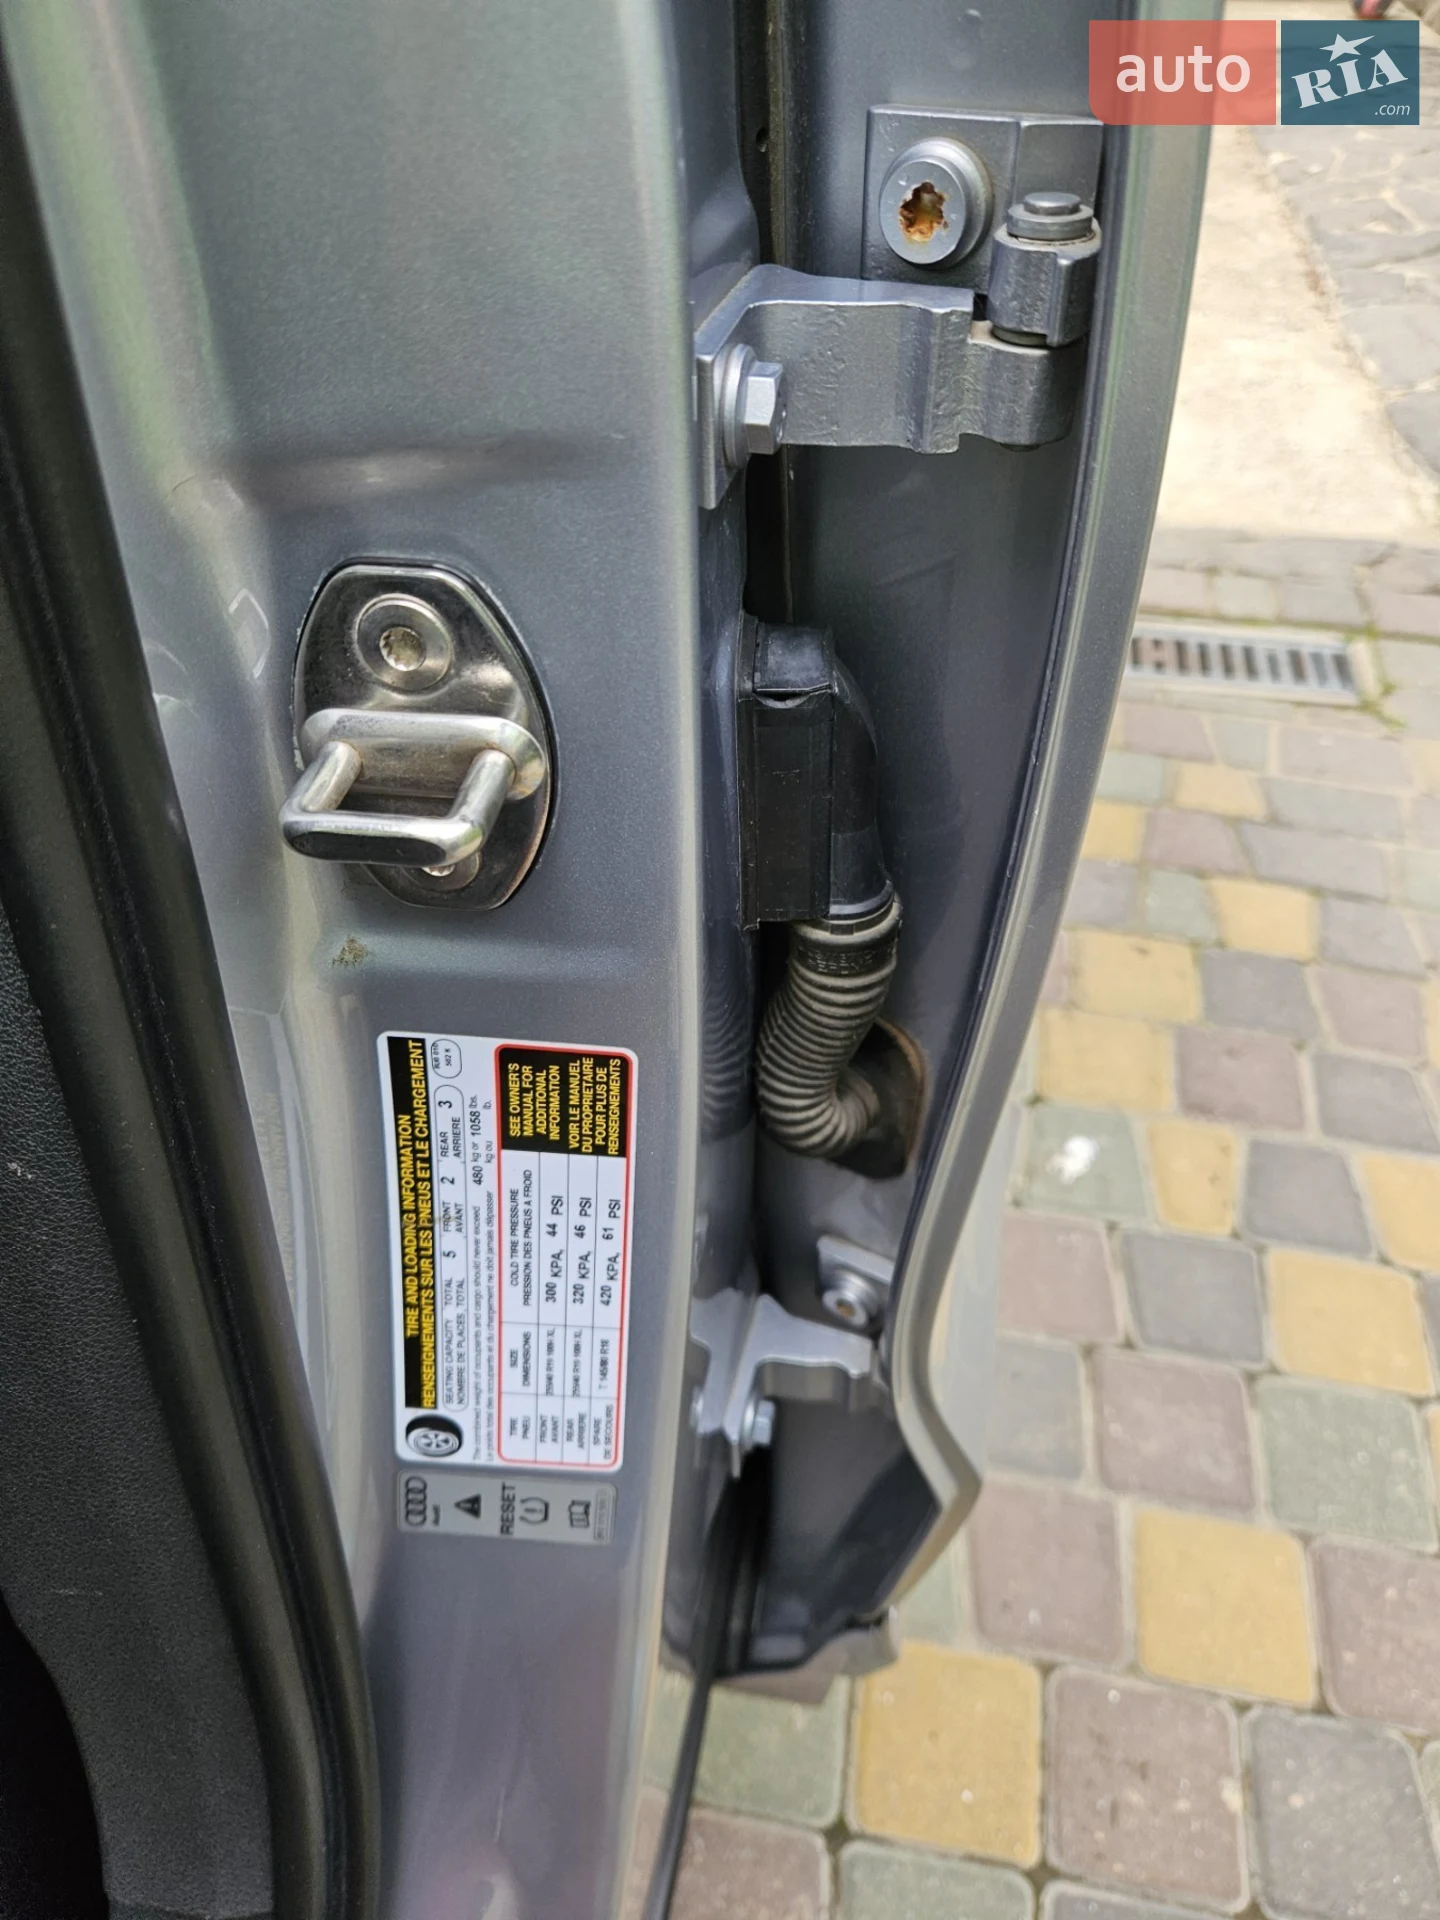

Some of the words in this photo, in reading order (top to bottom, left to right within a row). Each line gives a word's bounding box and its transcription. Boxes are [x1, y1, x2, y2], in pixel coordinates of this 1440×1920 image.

[508, 1063, 520, 1113] OWNER'S
[522, 1066, 532, 1088] FOR
[569, 1060, 580, 1104] MANUEL
[596, 1067, 607, 1082] DE
[409, 1039, 429, 1138] CHARGEMENT
[469, 1095, 478, 1109] lbs.
[536, 1070, 546, 1134] ADDITIONAL
[582, 1058, 593, 1134] PROPRIETAIRE
[596, 1084, 606, 1112] PLUS
[438, 1100, 452, 1109] 3
[523, 1091, 533, 1136] MANUAL
[549, 1065, 560, 1140] INFORMATION
[569, 1108, 580, 1120] LE
[609, 1059, 620, 1154] RENSEIGNEMENTS
[452, 1116, 461, 1158] ARRIERE
[470, 1110, 481, 1137] 1058
[510, 1116, 520, 1136] SEE
[569, 1123, 580, 1148] VOIR
[596, 1114, 606, 1145] POUR
[416, 1141, 429, 1158] LE
[440, 1132, 449, 1157] REAR
[470, 1153, 480, 1162] kg
[486, 1141, 492, 1151] ou
[582, 1137, 592, 1152] DU
[398, 1114, 416, 1210] INFORMATION
[416, 1161, 430, 1178] ET
[485, 1154, 495, 1163] kg
[440, 1176, 455, 1185] 2
[472, 1165, 484, 1185] 480
[523, 1170, 532, 1198] FROID
[417, 1182, 433, 1226] PNEUS
[442, 1201, 452, 1232] FRONT
[454, 1202, 463, 1233] AVANT
[510, 1188, 518, 1236] PRESSURE
[551, 1195, 563, 1215] PSI
[579, 1197, 592, 1217] PSI
[608, 1199, 620, 1218] PSI
[523, 1209, 532, 1239] PNEUS
[546, 1223, 557, 1237] 44
[574, 1224, 585, 1238] 46
[602, 1227, 614, 1240] 61
[402, 1213, 418, 1273] LOADING
[420, 1230, 432, 1255] LES
[442, 1250, 457, 1259] 5
[486, 1230, 495, 1255] jamais
[510, 1240, 518, 1259] TIRE
[524, 1242, 532, 1259] DES
[420, 1258, 434, 1286] SUR
[472, 1261, 481, 1287] should
[510, 1262, 519, 1286] COLD
[551, 1249, 564, 1278] KPA,
[578, 1251, 591, 1279] KPA,
[607, 1252, 620, 1280] KPA,
[404, 1276, 418, 1304] AND
[444, 1277, 452, 1306] TOTAL
[456, 1278, 464, 1307] TOTAL
[523, 1262, 532, 1306] PRESSION
[545, 1282, 556, 1303] 300
[573, 1284, 584, 1304] 320
[600, 1285, 612, 1306] 420
[474, 1289, 482, 1311] cargo
[405, 1308, 419, 1337] TIRE
[456, 1313, 465, 1348] PLACES
[420, 1288, 435, 1408] RENSEIGNEMENTS
[444, 1318, 454, 1364] CAPACITY
[456, 1350, 465, 1362] DE
[510, 1349, 518, 1368] SIZE
[523, 1332, 531, 1386] DIMENSIONS
[445, 1366, 454, 1404] SEATING
[457, 1366, 466, 1405] NOMBRE
[522, 1416, 530, 1439] PNEU
[540, 1414, 548, 1442] FRONT
[566, 1419, 574, 1441] REAR
[578, 1413, 586, 1449] ARRIERE
[593, 1417, 602, 1445] SPARE
[604, 1404, 613, 1446] SECOURS
[604, 1449, 611, 1459] DE
[500, 1482, 515, 1535] RESET
